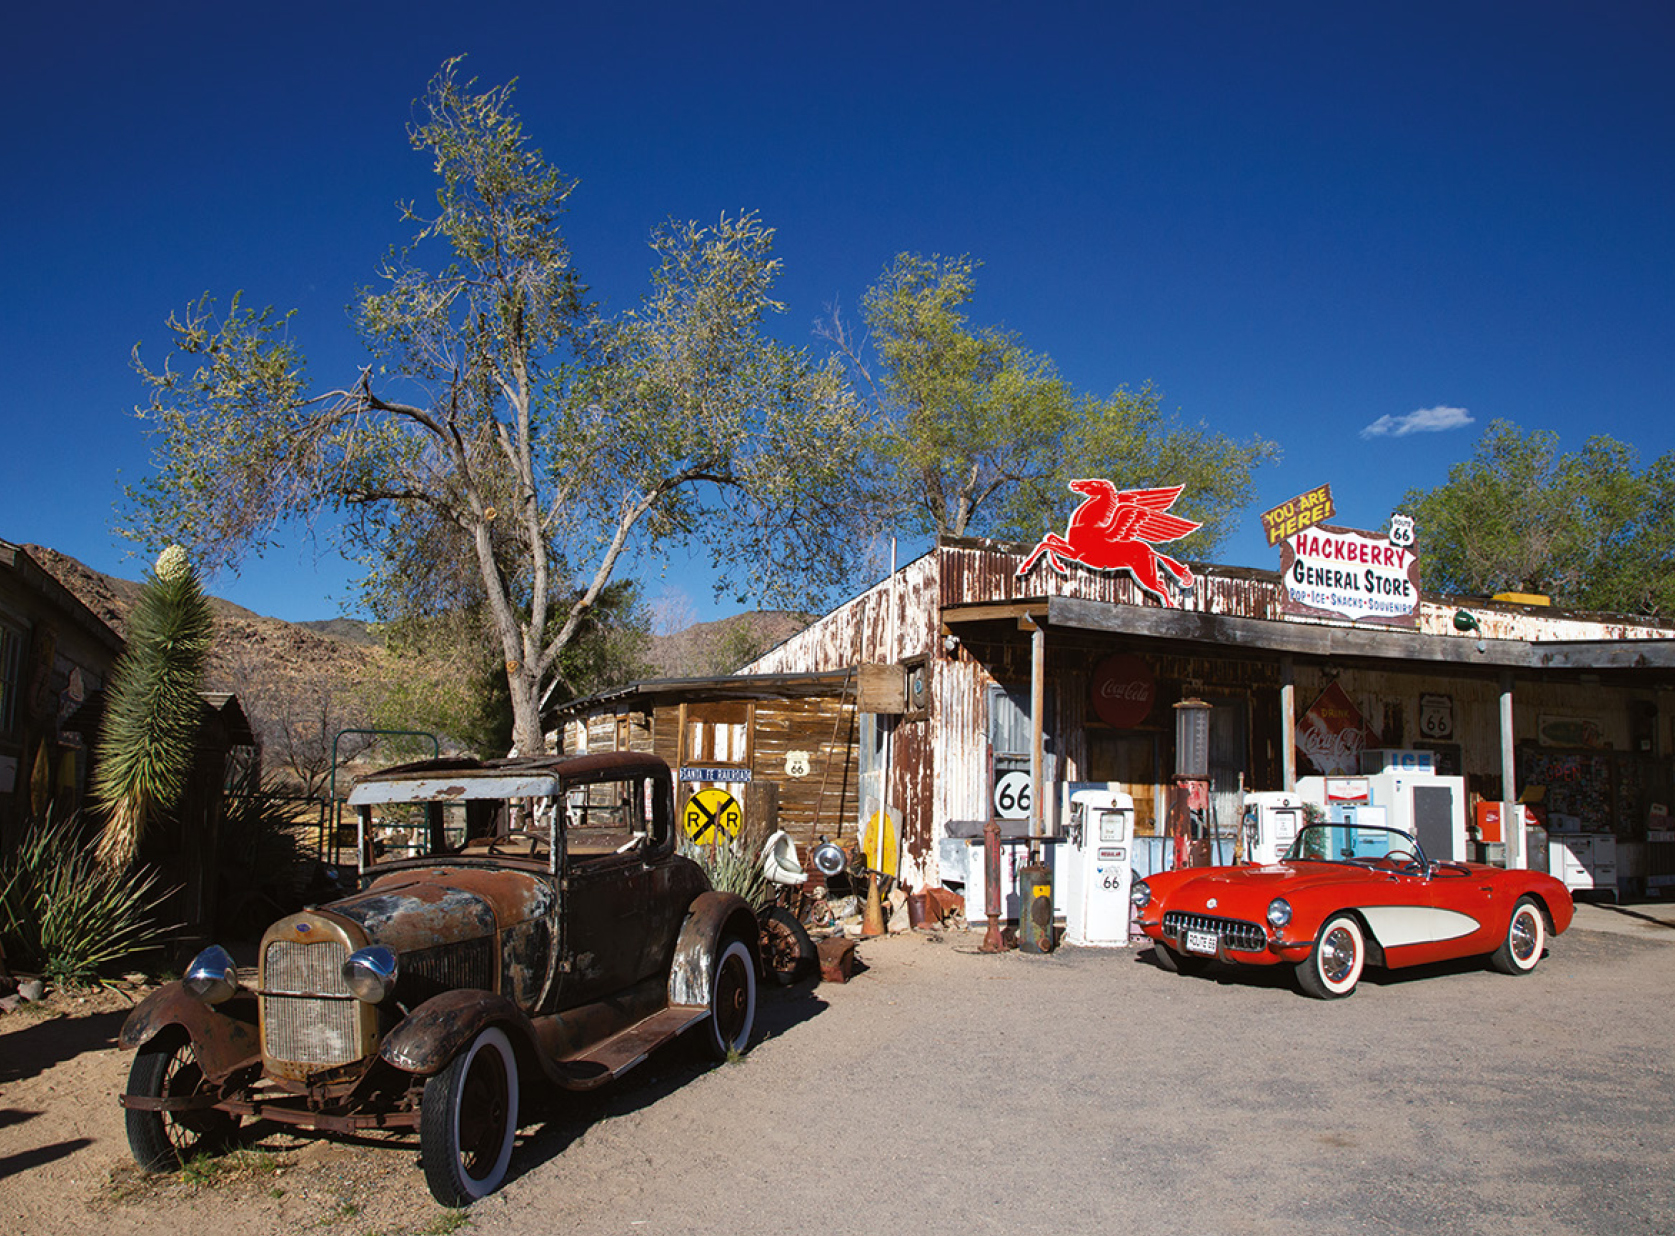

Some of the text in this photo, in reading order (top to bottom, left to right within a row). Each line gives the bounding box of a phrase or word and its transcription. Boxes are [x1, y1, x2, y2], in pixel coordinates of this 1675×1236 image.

[1265, 488, 1328, 526] YOU ARE
[1269, 501, 1332, 543] HERE!
[1393, 528, 1410, 542] 66
[1296, 533, 1406, 569] HACKBERRY
[1293, 558, 1410, 597] GENERAL STORE
[1321, 708, 1350, 719] DRINK
[1426, 715, 1447, 732] 66
[790, 764, 804, 774] 66
[1392, 753, 1431, 772] ICE
[1545, 764, 1582, 782] OPEN
[999, 782, 1031, 811] 66
[687, 812, 738, 828] R R
[1103, 875, 1120, 889] 66
[1189, 934, 1207, 949] ROUTE
